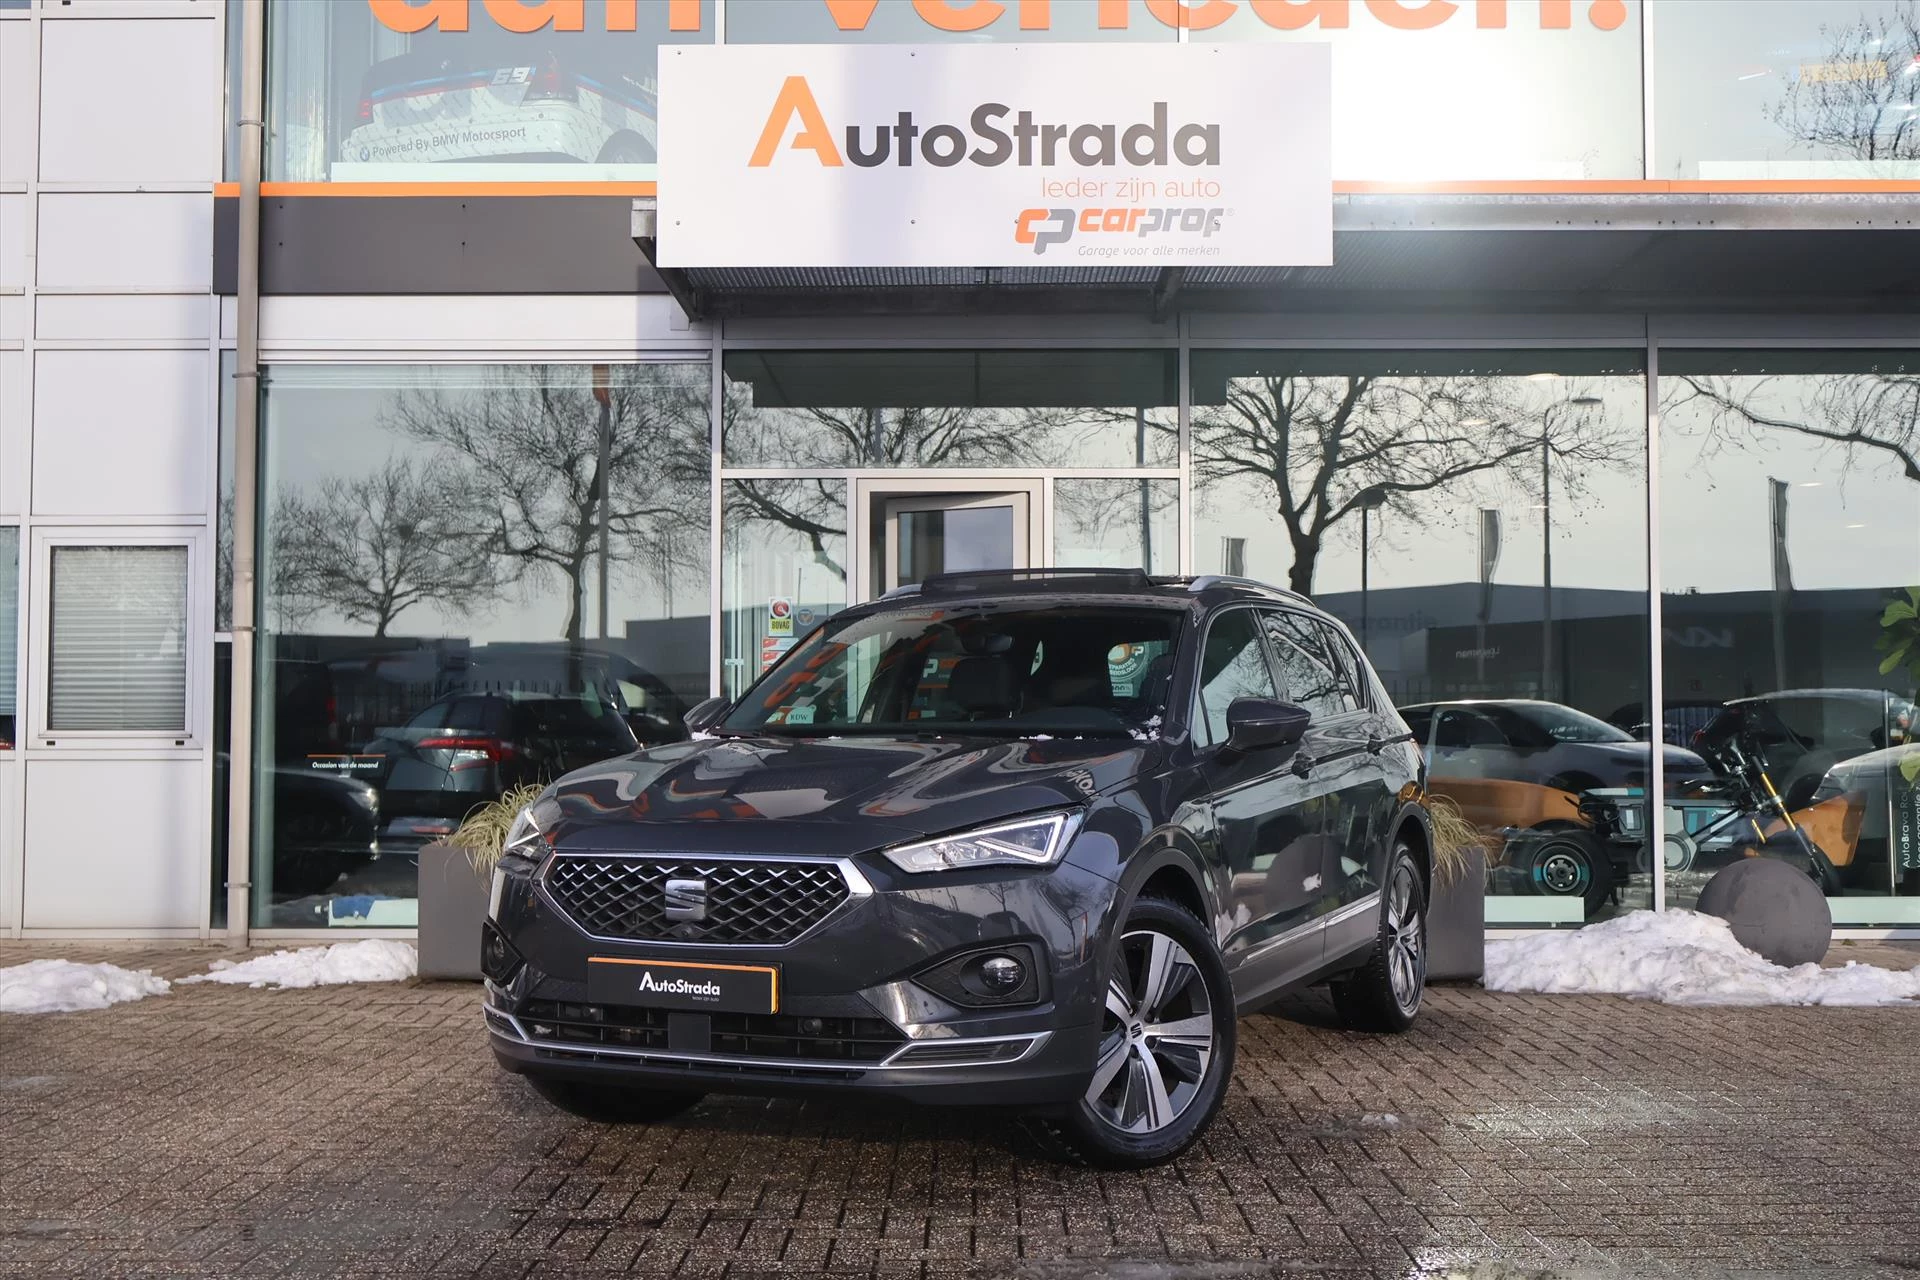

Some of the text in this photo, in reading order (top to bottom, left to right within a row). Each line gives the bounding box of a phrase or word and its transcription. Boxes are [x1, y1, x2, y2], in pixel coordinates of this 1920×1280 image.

[748, 76, 1220, 168] AutoStrada
[373, 125, 526, 157] Powered By BMW Motorsport
[1042, 176, 1221, 203] Ieder zijn auto
[1078, 245, 1220, 258] Garage voor alle merken
[771, 618, 790, 630] BOVAG
[312, 761, 337, 769] Occasion
[349, 761, 357, 769] de
[358, 761, 379, 769] maand
[1902, 811, 1911, 868] AutoBrava
[639, 971, 720, 996] AutoStrada
